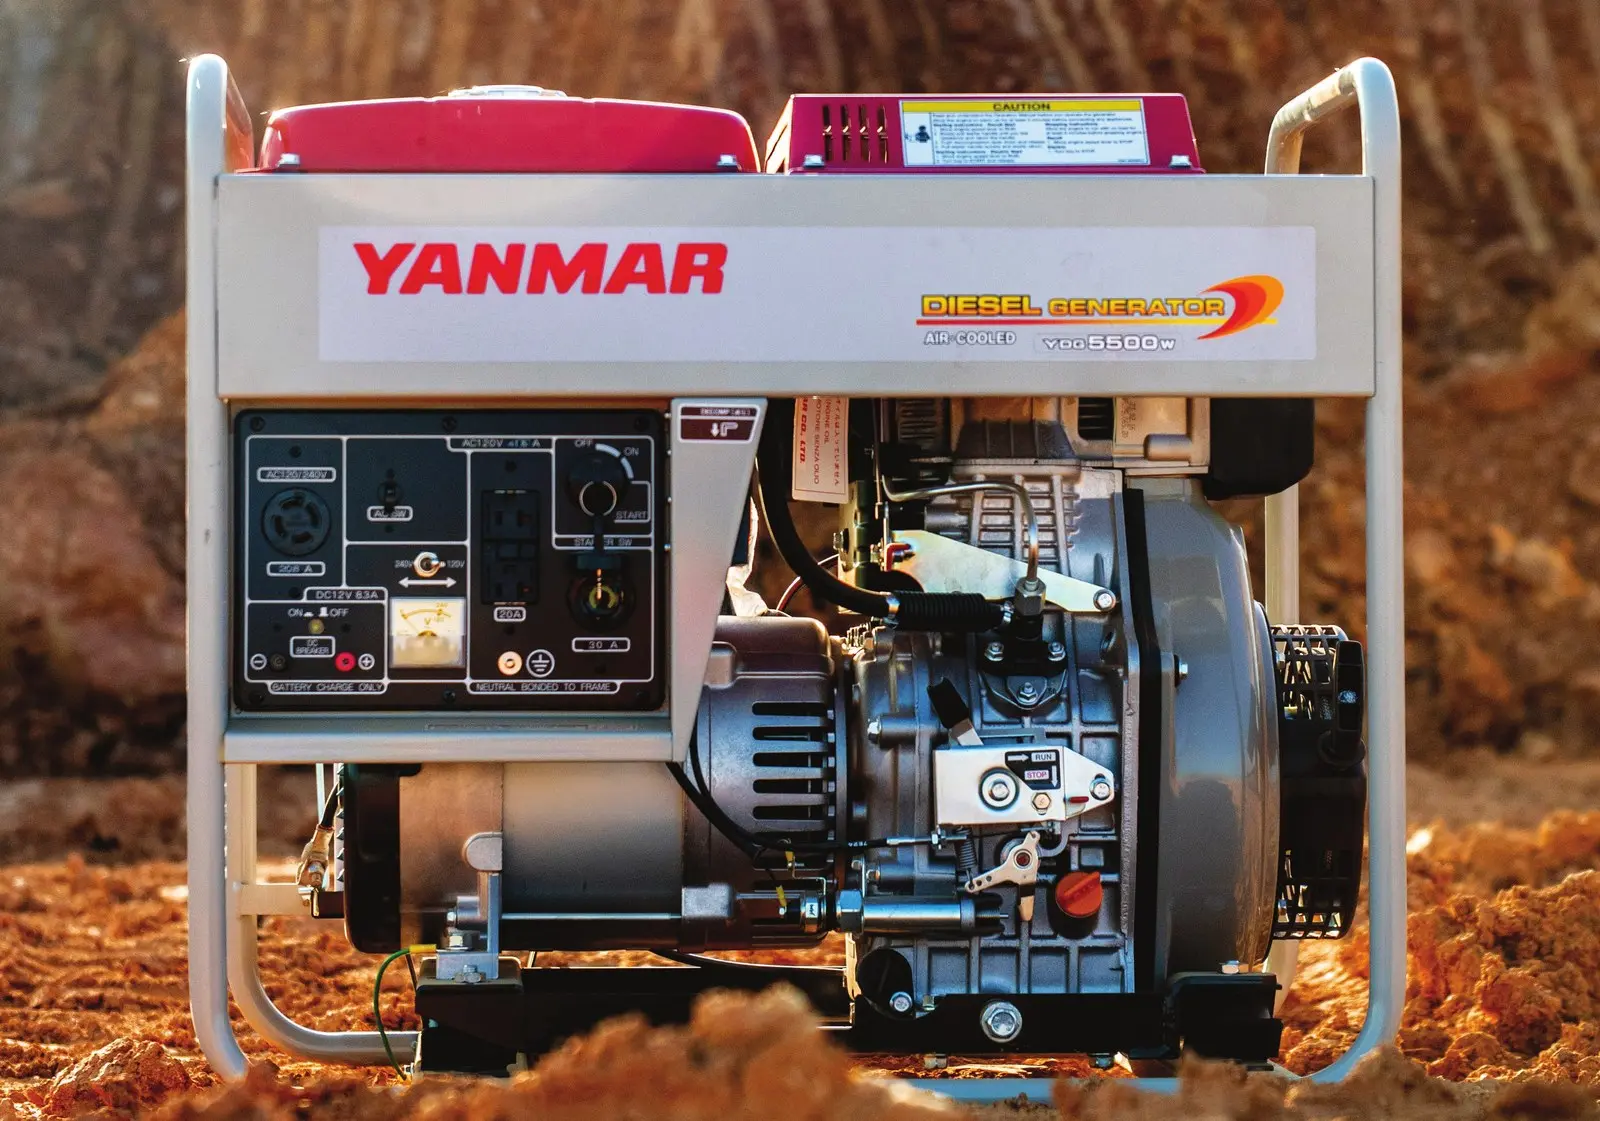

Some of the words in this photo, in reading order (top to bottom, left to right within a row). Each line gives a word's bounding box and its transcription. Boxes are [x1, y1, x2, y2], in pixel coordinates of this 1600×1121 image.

[993, 103, 1051, 111] CAUTION
[353, 243, 728, 294] YANMAR
[921, 294, 1042, 317] DIESEL
[1047, 298, 1226, 317] GENERATOR
[462, 439, 503, 447] AC120V
[574, 439, 593, 448] OFF
[624, 447, 639, 456] ON
[615, 511, 647, 520] START
[619, 537, 633, 546] SW
[315, 591, 352, 599] DC12V
[288, 608, 303, 617] ON
[330, 608, 349, 617] OFF
[499, 610, 521, 619] 20A
[588, 640, 603, 649] 30
[610, 640, 618, 649] A
[272, 682, 311, 691] BATTERY
[316, 682, 354, 691] CHARGE
[358, 682, 382, 691] ONLY
[476, 683, 516, 692] NEUTRAL
[521, 683, 559, 692] BONDED
[564, 683, 576, 692] TO
[580, 683, 611, 692] FRAME
[1026, 771, 1048, 779] STOP
